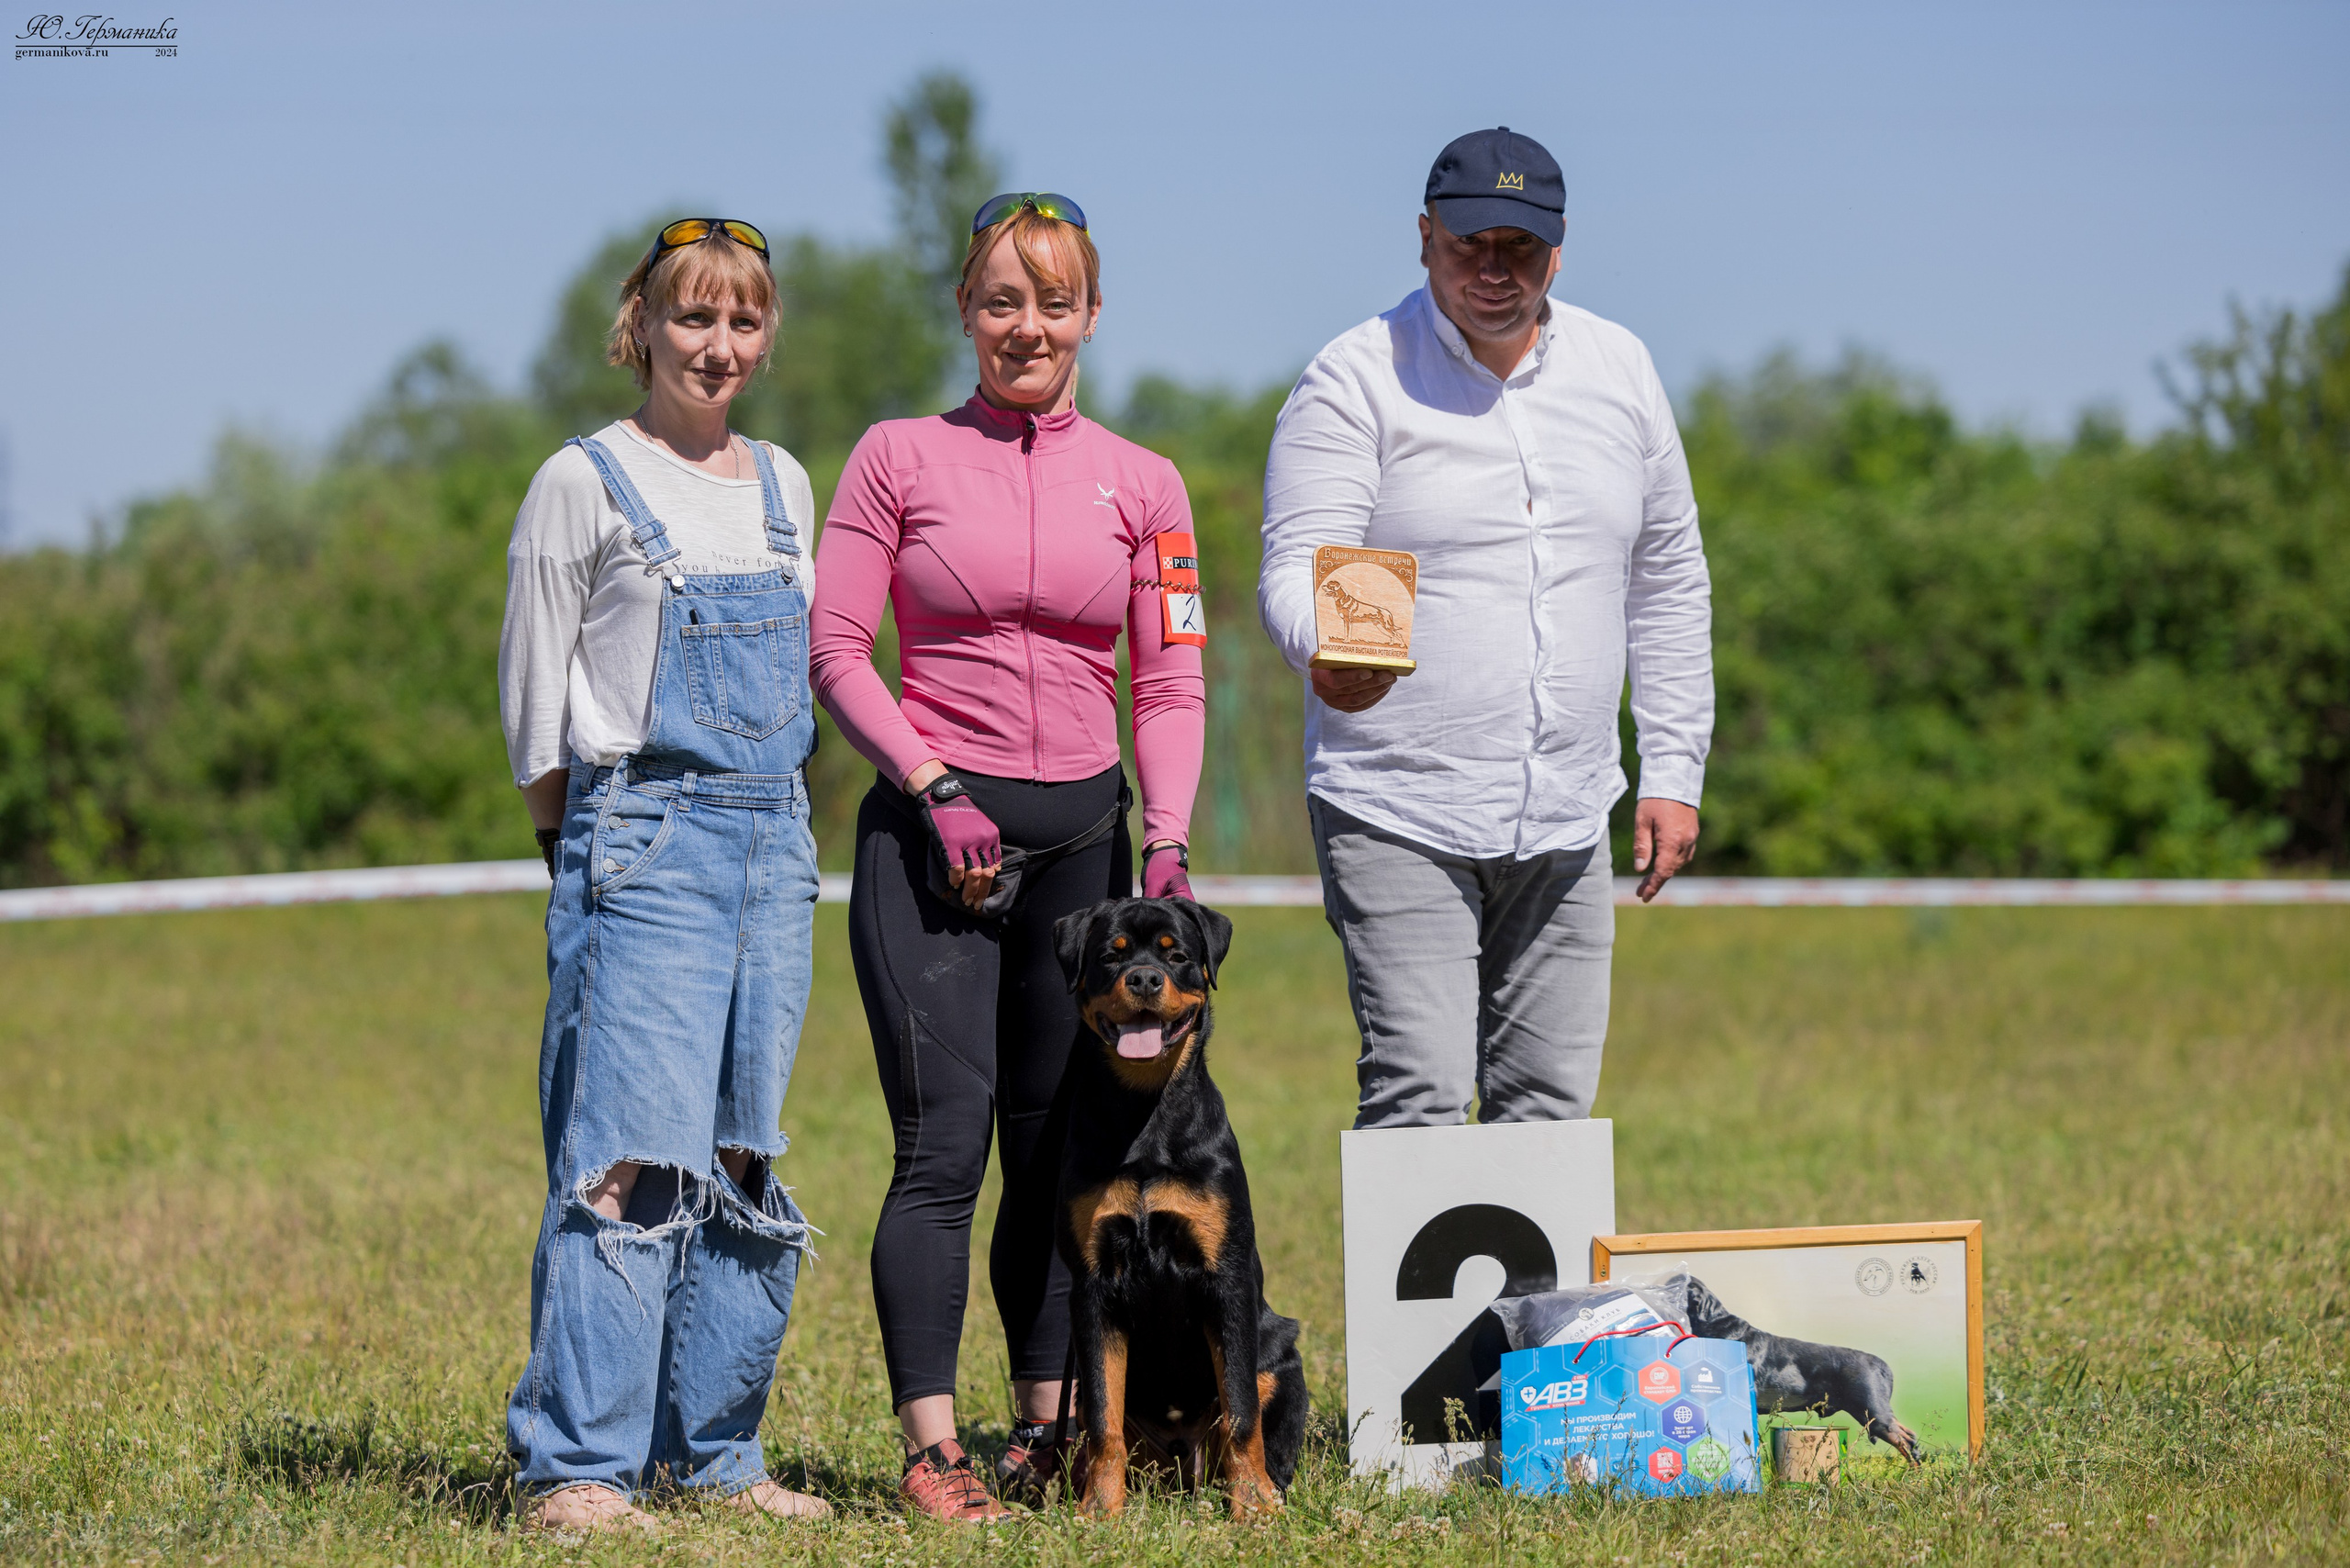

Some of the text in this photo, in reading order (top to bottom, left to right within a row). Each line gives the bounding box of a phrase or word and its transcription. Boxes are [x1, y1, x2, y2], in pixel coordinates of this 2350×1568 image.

[1324, 547, 1412, 566] Воронежские встречи
[681, 564, 708, 574] you
[1320, 644, 1355, 654] МОНОПОРОДНАЯ
[1355, 646, 1378, 655] ВЫСТАВКА
[1396, 1204, 1558, 1446] 2
[1576, 1412, 1638, 1425] ПРОИЗВОДИМ
